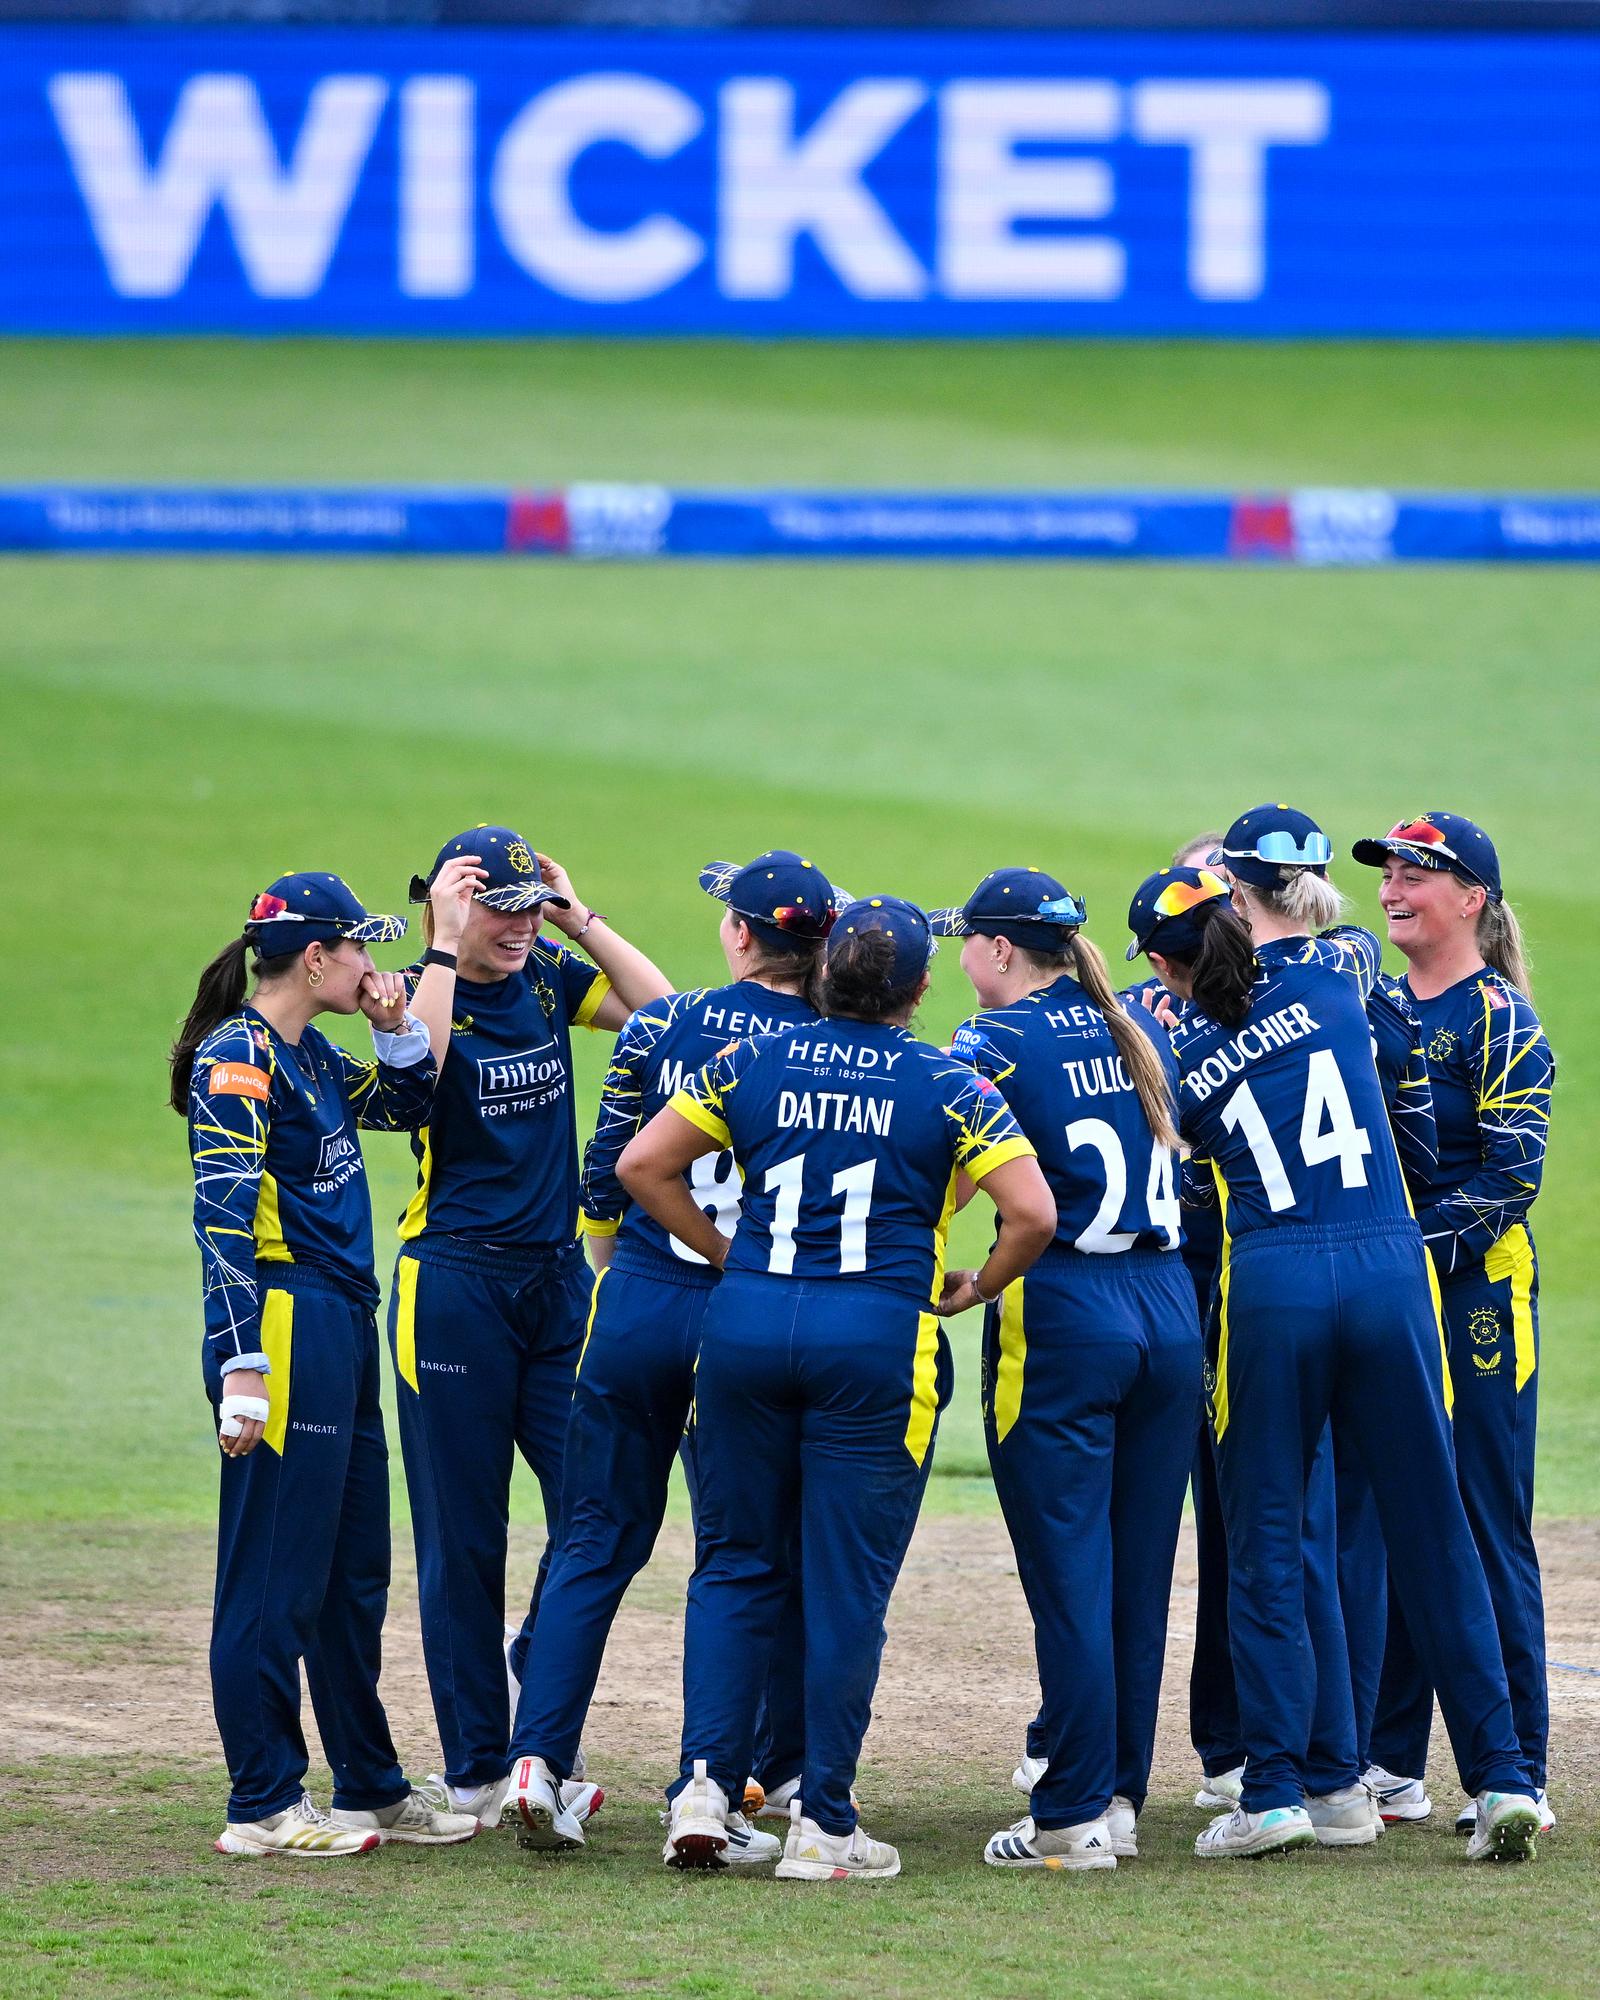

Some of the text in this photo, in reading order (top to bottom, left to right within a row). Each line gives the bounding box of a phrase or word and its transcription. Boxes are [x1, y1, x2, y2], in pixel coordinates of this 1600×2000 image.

[47, 72, 1331, 304] WICKET
[788, 1040, 903, 1071] HENDY
[814, 1067, 865, 1080] EST. 1859
[1185, 1002, 1321, 1101] BOUCHIER
[481, 1081, 567, 1117] FOR THE STAY
[777, 1091, 895, 1136] DATTANI
[1220, 1049, 1372, 1213] 14
[1065, 1118, 1182, 1255] 24
[764, 1153, 877, 1275] 11
[420, 1360, 468, 1374] BARGATE
[292, 1421, 338, 1434] BARGATE
